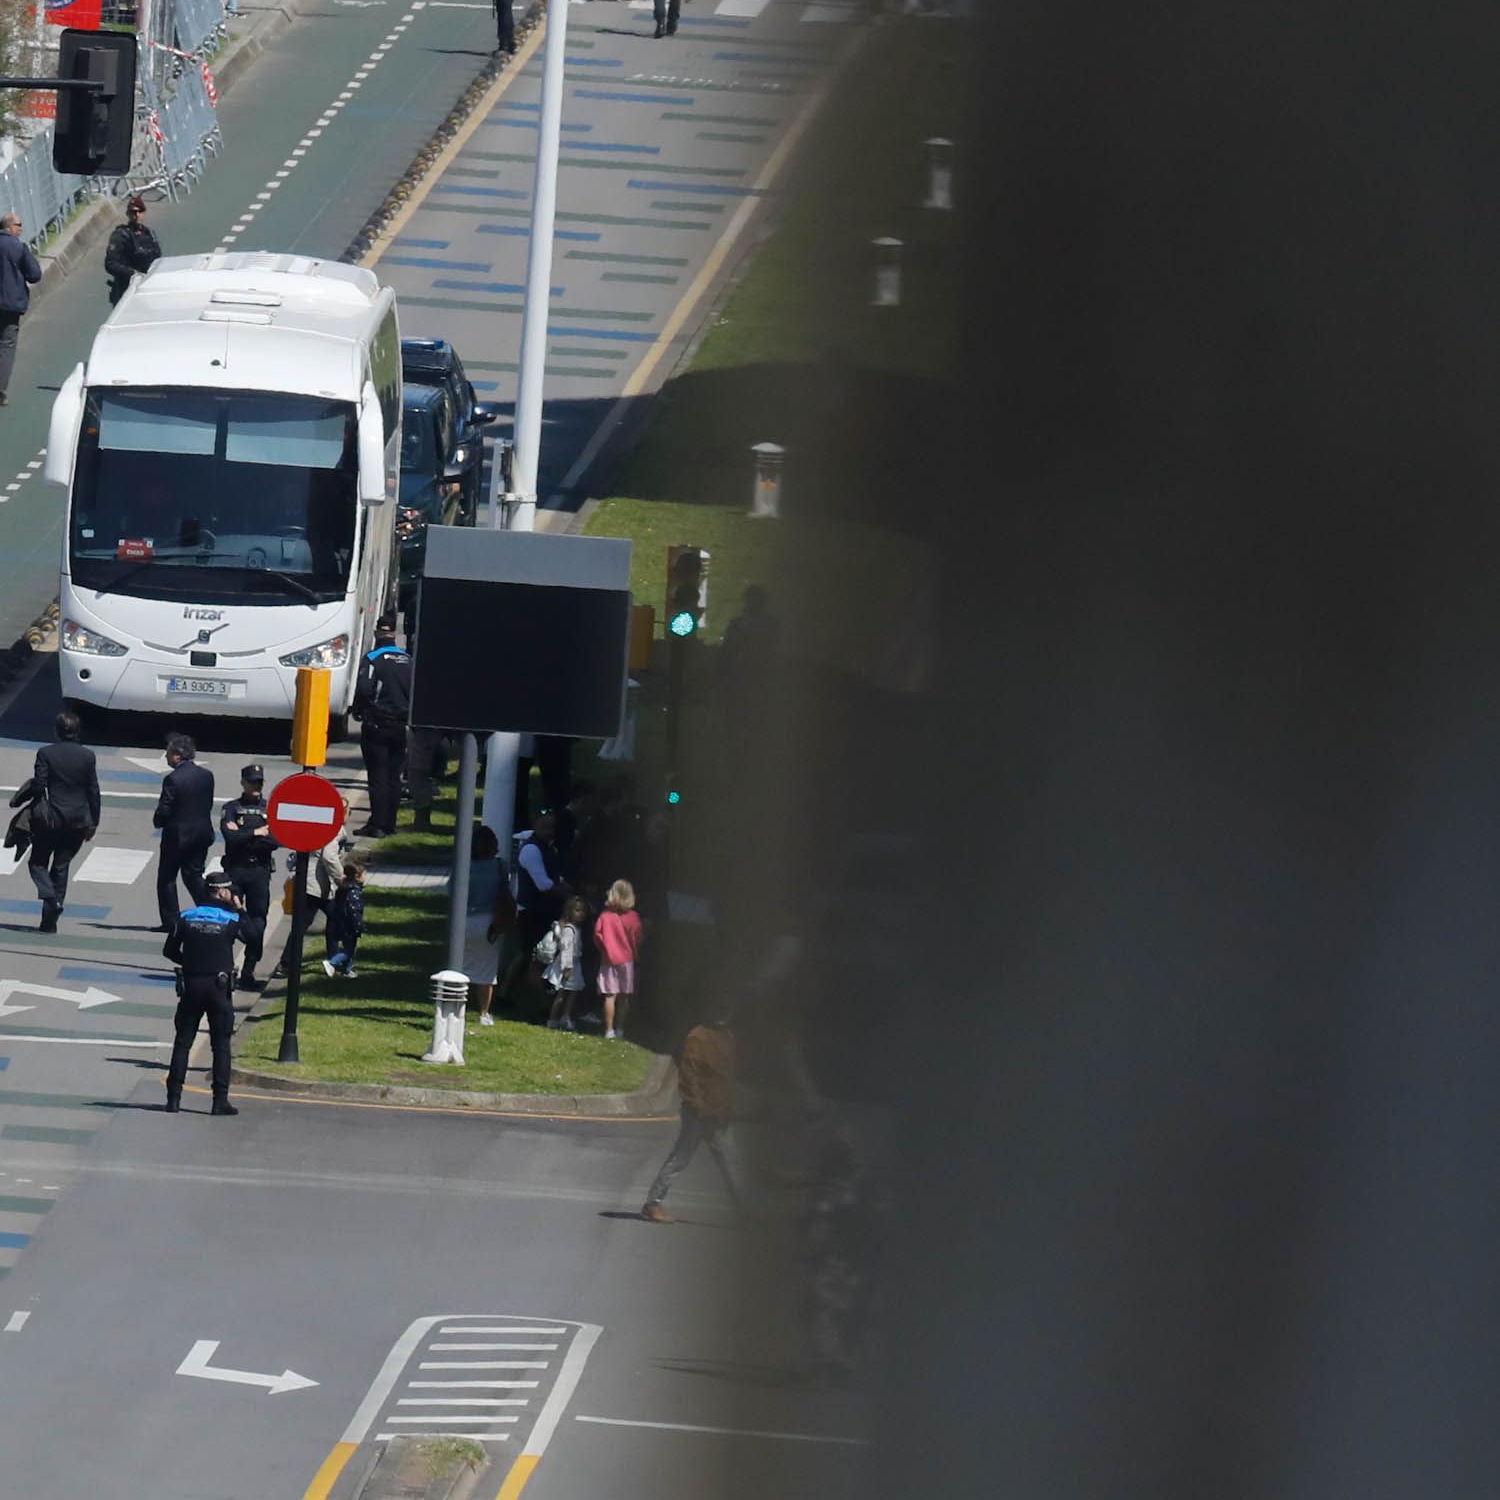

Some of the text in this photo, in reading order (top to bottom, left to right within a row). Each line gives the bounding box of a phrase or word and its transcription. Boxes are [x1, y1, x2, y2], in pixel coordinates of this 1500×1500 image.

[176, 678, 226, 692] EA 9305 3
